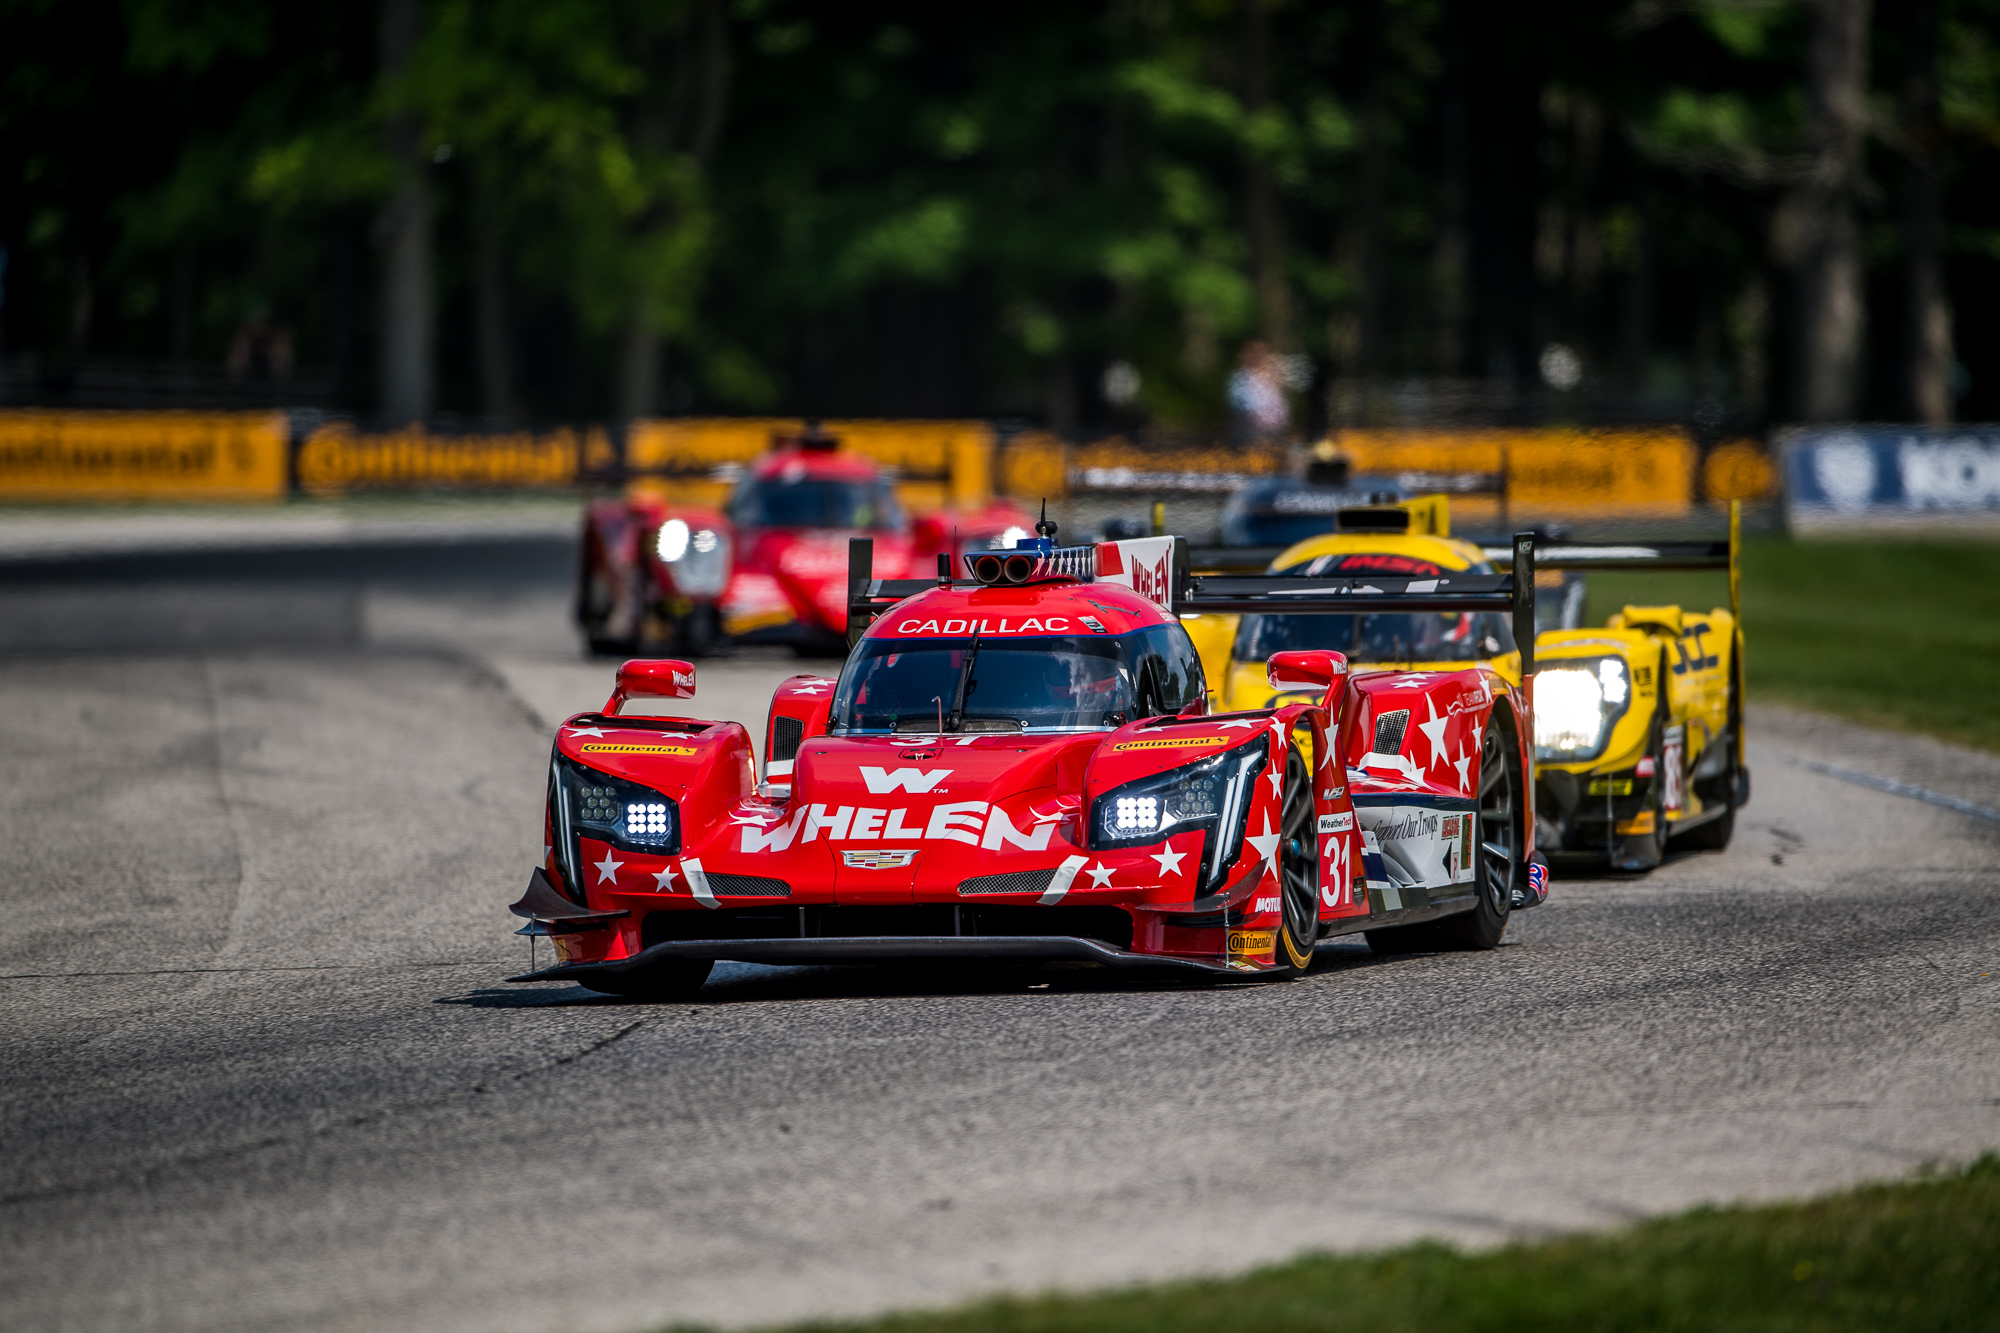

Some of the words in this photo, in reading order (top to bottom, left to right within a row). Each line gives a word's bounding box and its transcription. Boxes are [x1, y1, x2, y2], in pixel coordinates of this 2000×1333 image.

[1131, 549, 1169, 604] WHELEN
[897, 617, 1070, 634] CADILLAC
[583, 744, 678, 753] Continental
[1115, 738, 1210, 750] Continental
[741, 801, 1056, 852] WHELEN
[1320, 816, 1352, 829] WeatherTech
[1401, 814, 1418, 840] Our
[1321, 834, 1350, 908] 31
[1228, 932, 1273, 952] Continental
